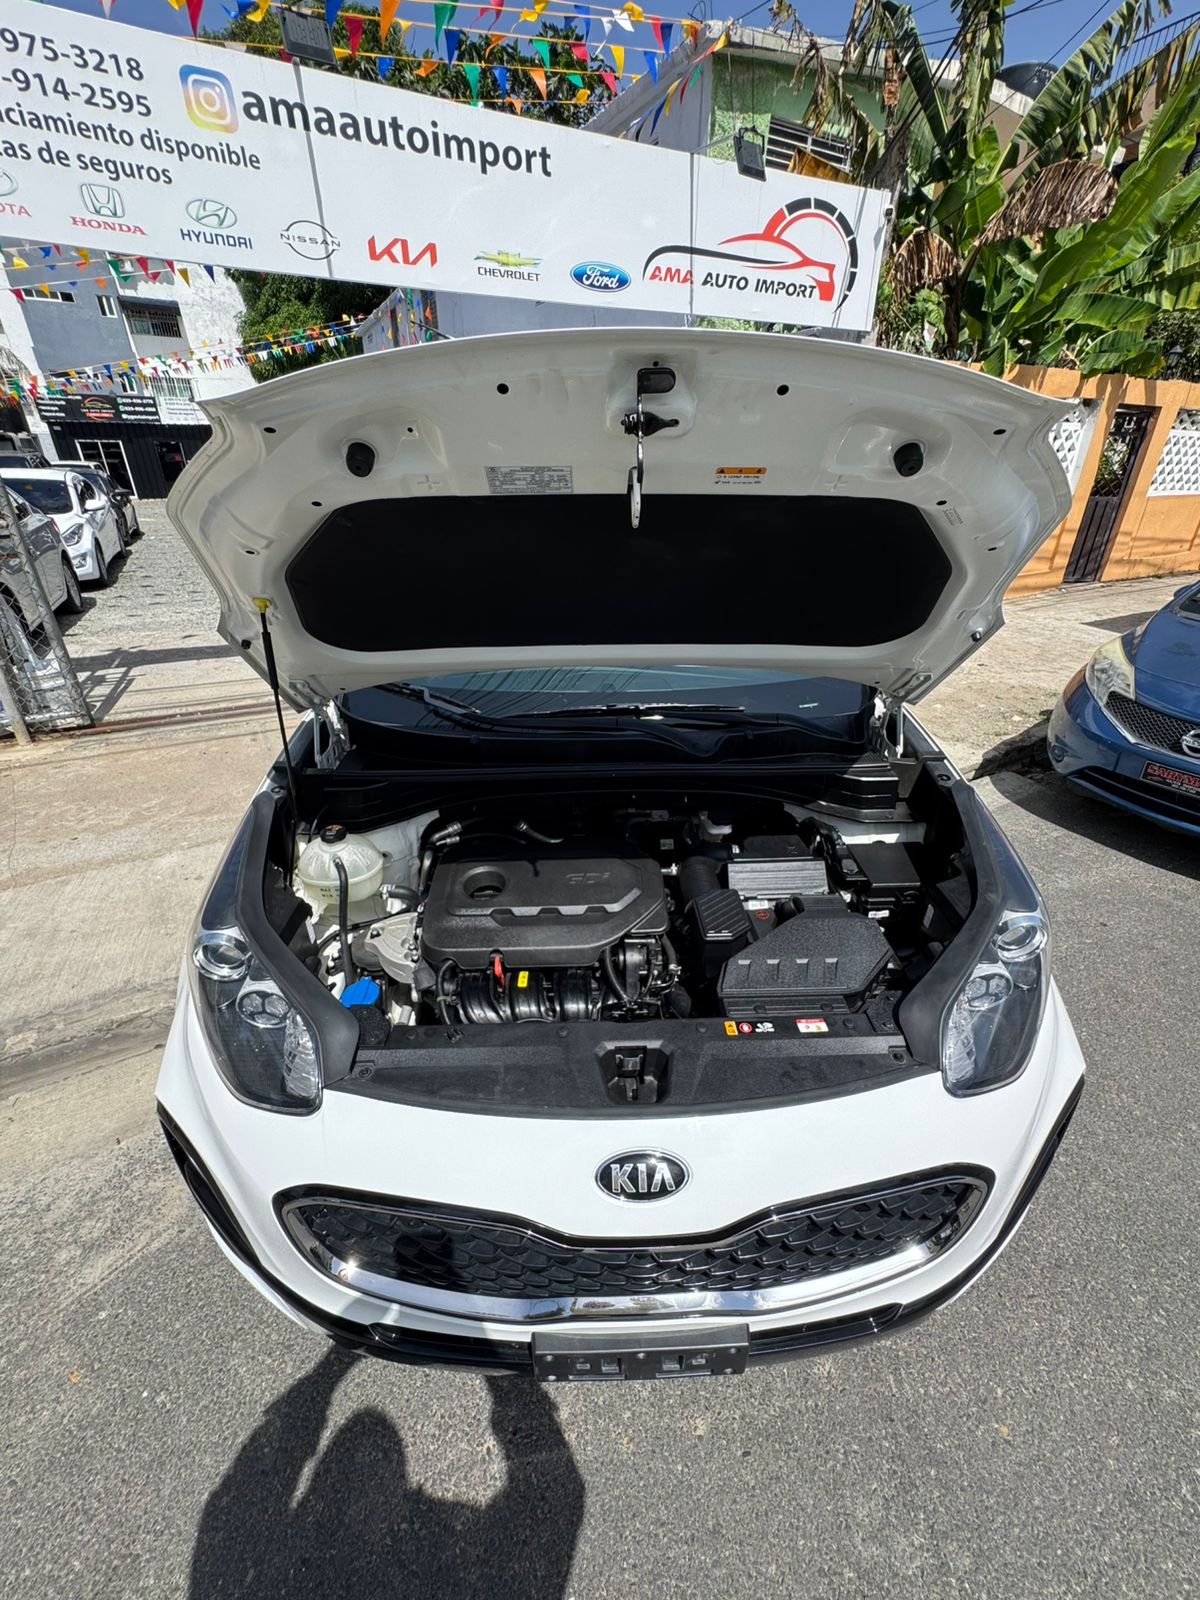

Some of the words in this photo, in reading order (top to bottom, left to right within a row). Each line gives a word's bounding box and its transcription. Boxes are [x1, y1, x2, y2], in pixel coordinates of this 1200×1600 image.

[0, 27, 145, 82] 975-3218
[1, 67, 152, 118] -914-2595
[140, 127, 262, 171] disponible
[241, 90, 552, 178] amaautoimport
[0, 140, 32, 161] as
[37, 140, 71, 168] de
[76, 152, 173, 186] seguros
[70, 215, 147, 236] HONDA
[180, 228, 253, 250] HYUNDAI
[280, 232, 341, 249] NISSAN
[367, 235, 438, 268] KIA
[477, 266, 541, 283] CHEVROLET
[582, 265, 619, 289] Ford
[649, 265, 694, 285] AMA
[701, 272, 749, 291] AUTO
[754, 279, 817, 299] IMPORT
[610, 1162, 676, 1193] KIA
